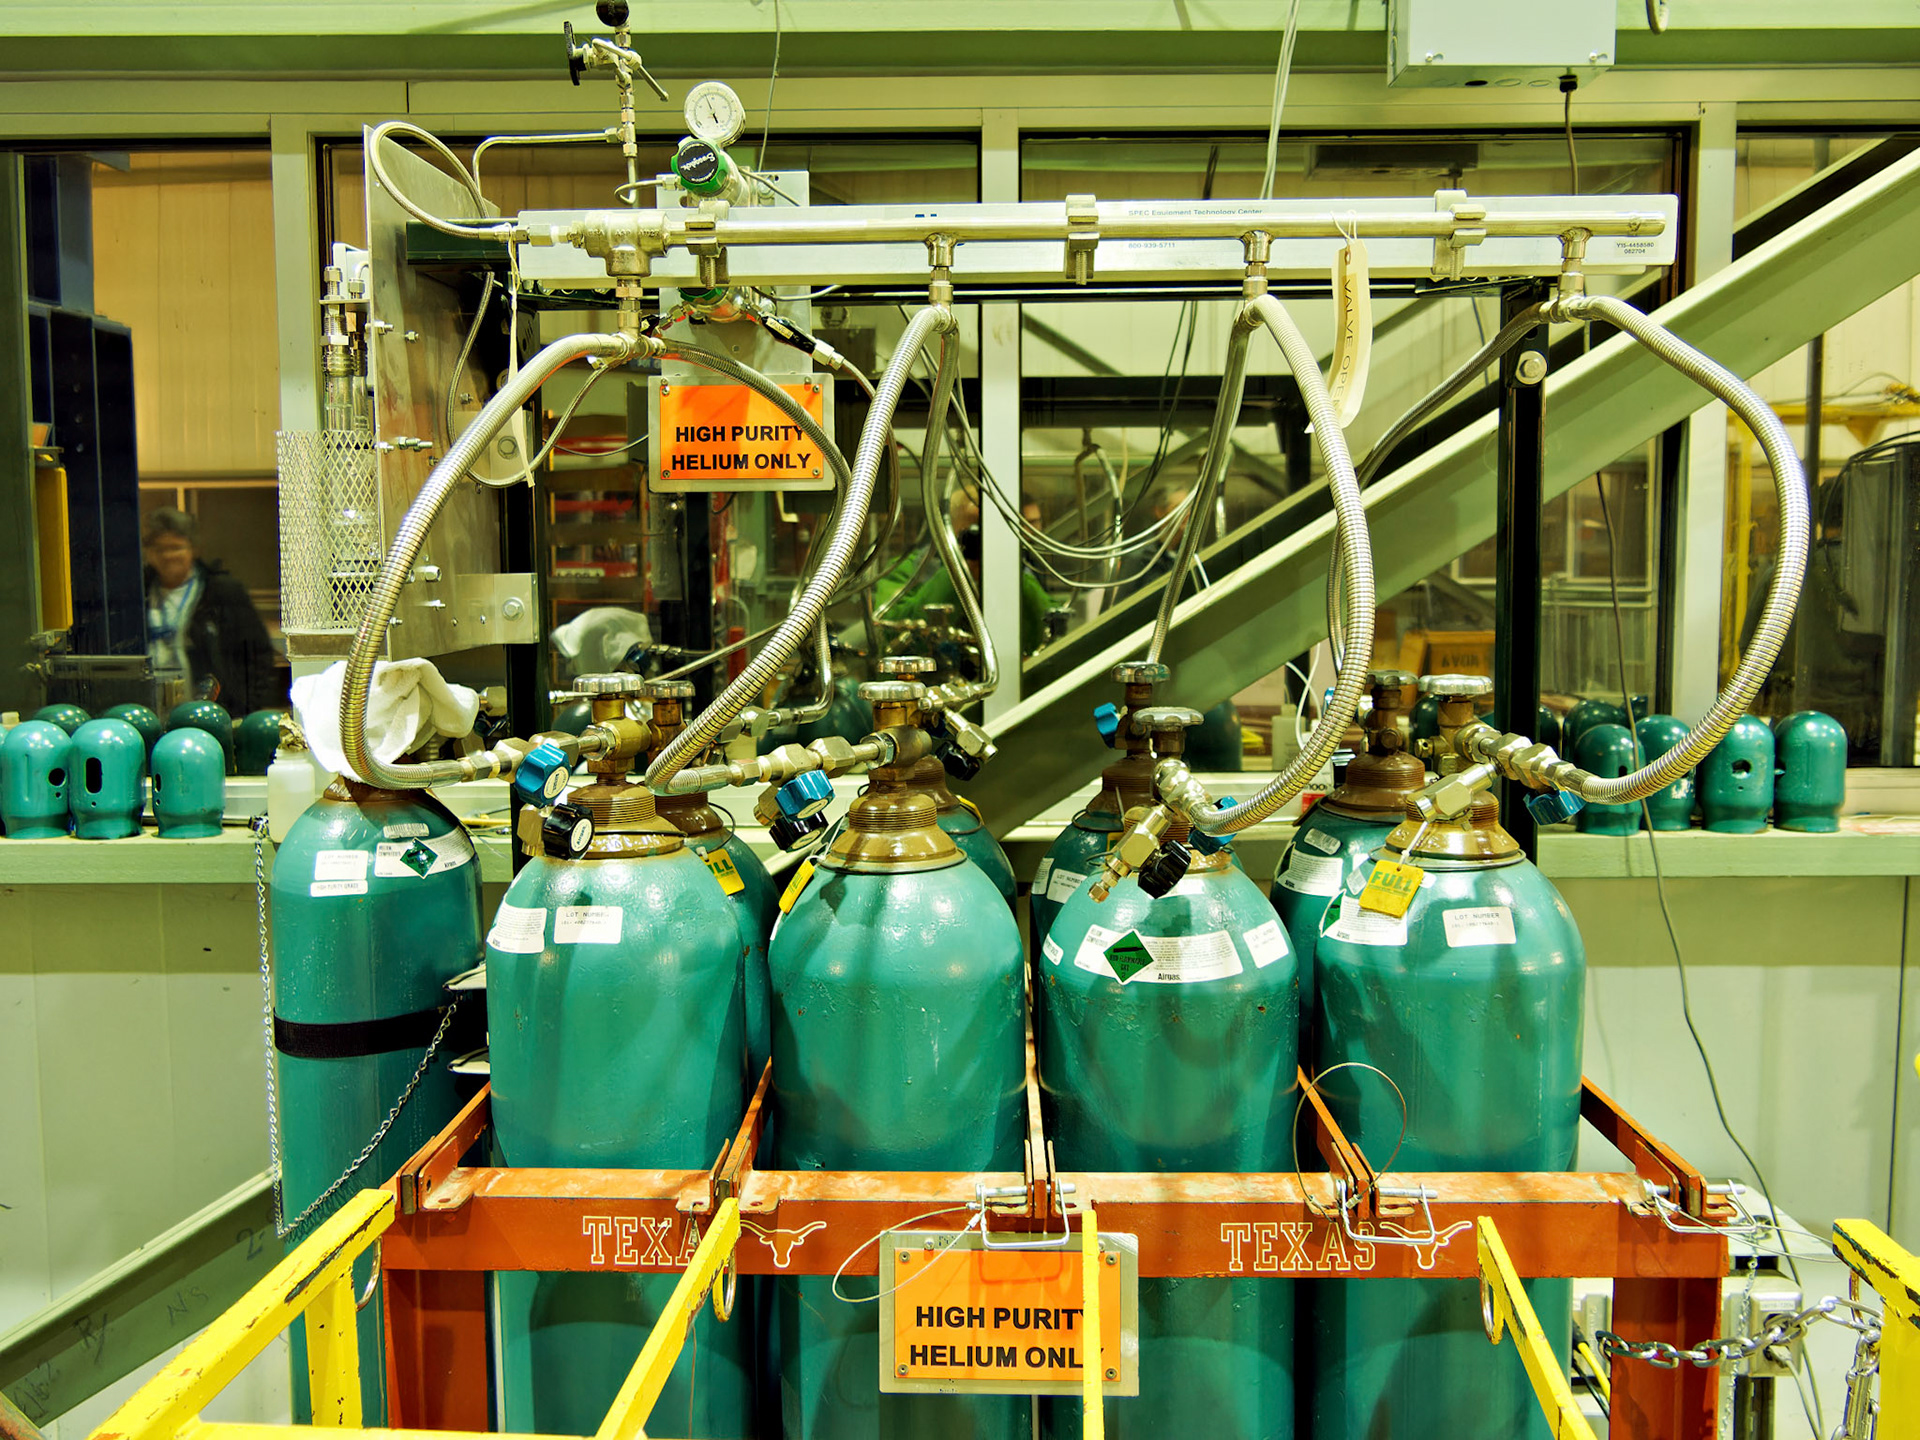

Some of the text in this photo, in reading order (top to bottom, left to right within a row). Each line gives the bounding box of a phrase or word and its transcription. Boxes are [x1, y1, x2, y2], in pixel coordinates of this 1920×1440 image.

[1343, 279, 1353, 347] VALVE
[675, 425, 805, 442] HIGH PURITY
[672, 453, 812, 470] HELIUM ONLY
[1371, 870, 1413, 892] FULL
[582, 1215, 702, 1266] TEXA
[1220, 1221, 1376, 1271] TEXAS
[915, 1305, 1083, 1330] HIGH PURIT
[910, 1345, 1084, 1369] HELIUM ONL
